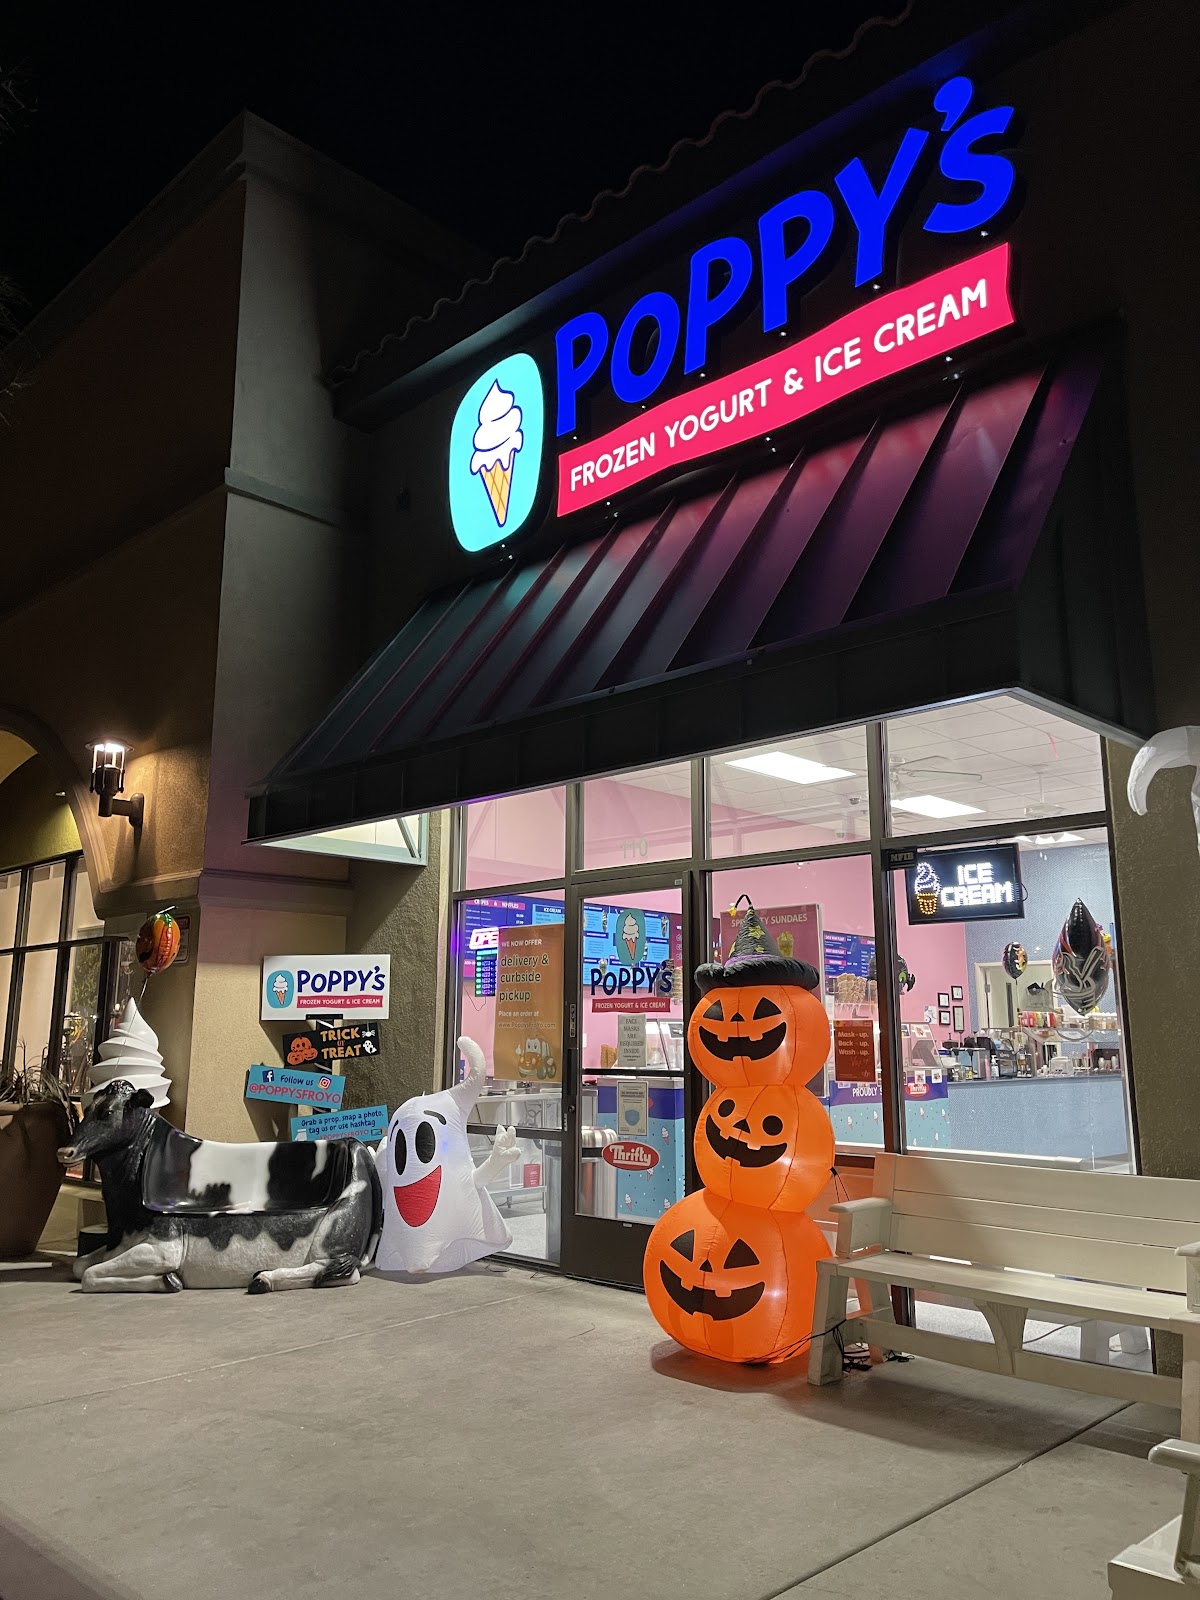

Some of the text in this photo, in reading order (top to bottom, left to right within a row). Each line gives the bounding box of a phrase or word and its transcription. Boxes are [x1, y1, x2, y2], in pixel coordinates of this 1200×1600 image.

[570, 279, 987, 491] FROZEN YOGURT & ICE CREAM
[618, 836, 648, 859] 110
[957, 862, 995, 885] ICE
[941, 881, 1014, 907] CREAM
[771, 913, 808, 924] SUNDAES
[472, 929, 499, 947] OPE
[500, 952, 549, 968] delivery &
[500, 970, 541, 983] curbside
[499, 989, 531, 1004] pickup
[320, 1027, 361, 1042] TRICK
[321, 1044, 362, 1060] TREAT
[280, 1075, 304, 1085] Follow
[249, 1083, 342, 1104] @POPPYSFROYO
[852, 1087, 877, 1097] PROUDLY
[342, 1114, 357, 1122] snap
[308, 1126, 320, 1135] tag
[350, 1120, 376, 1128] hashtag
[610, 1145, 651, 1166] Thrifty
